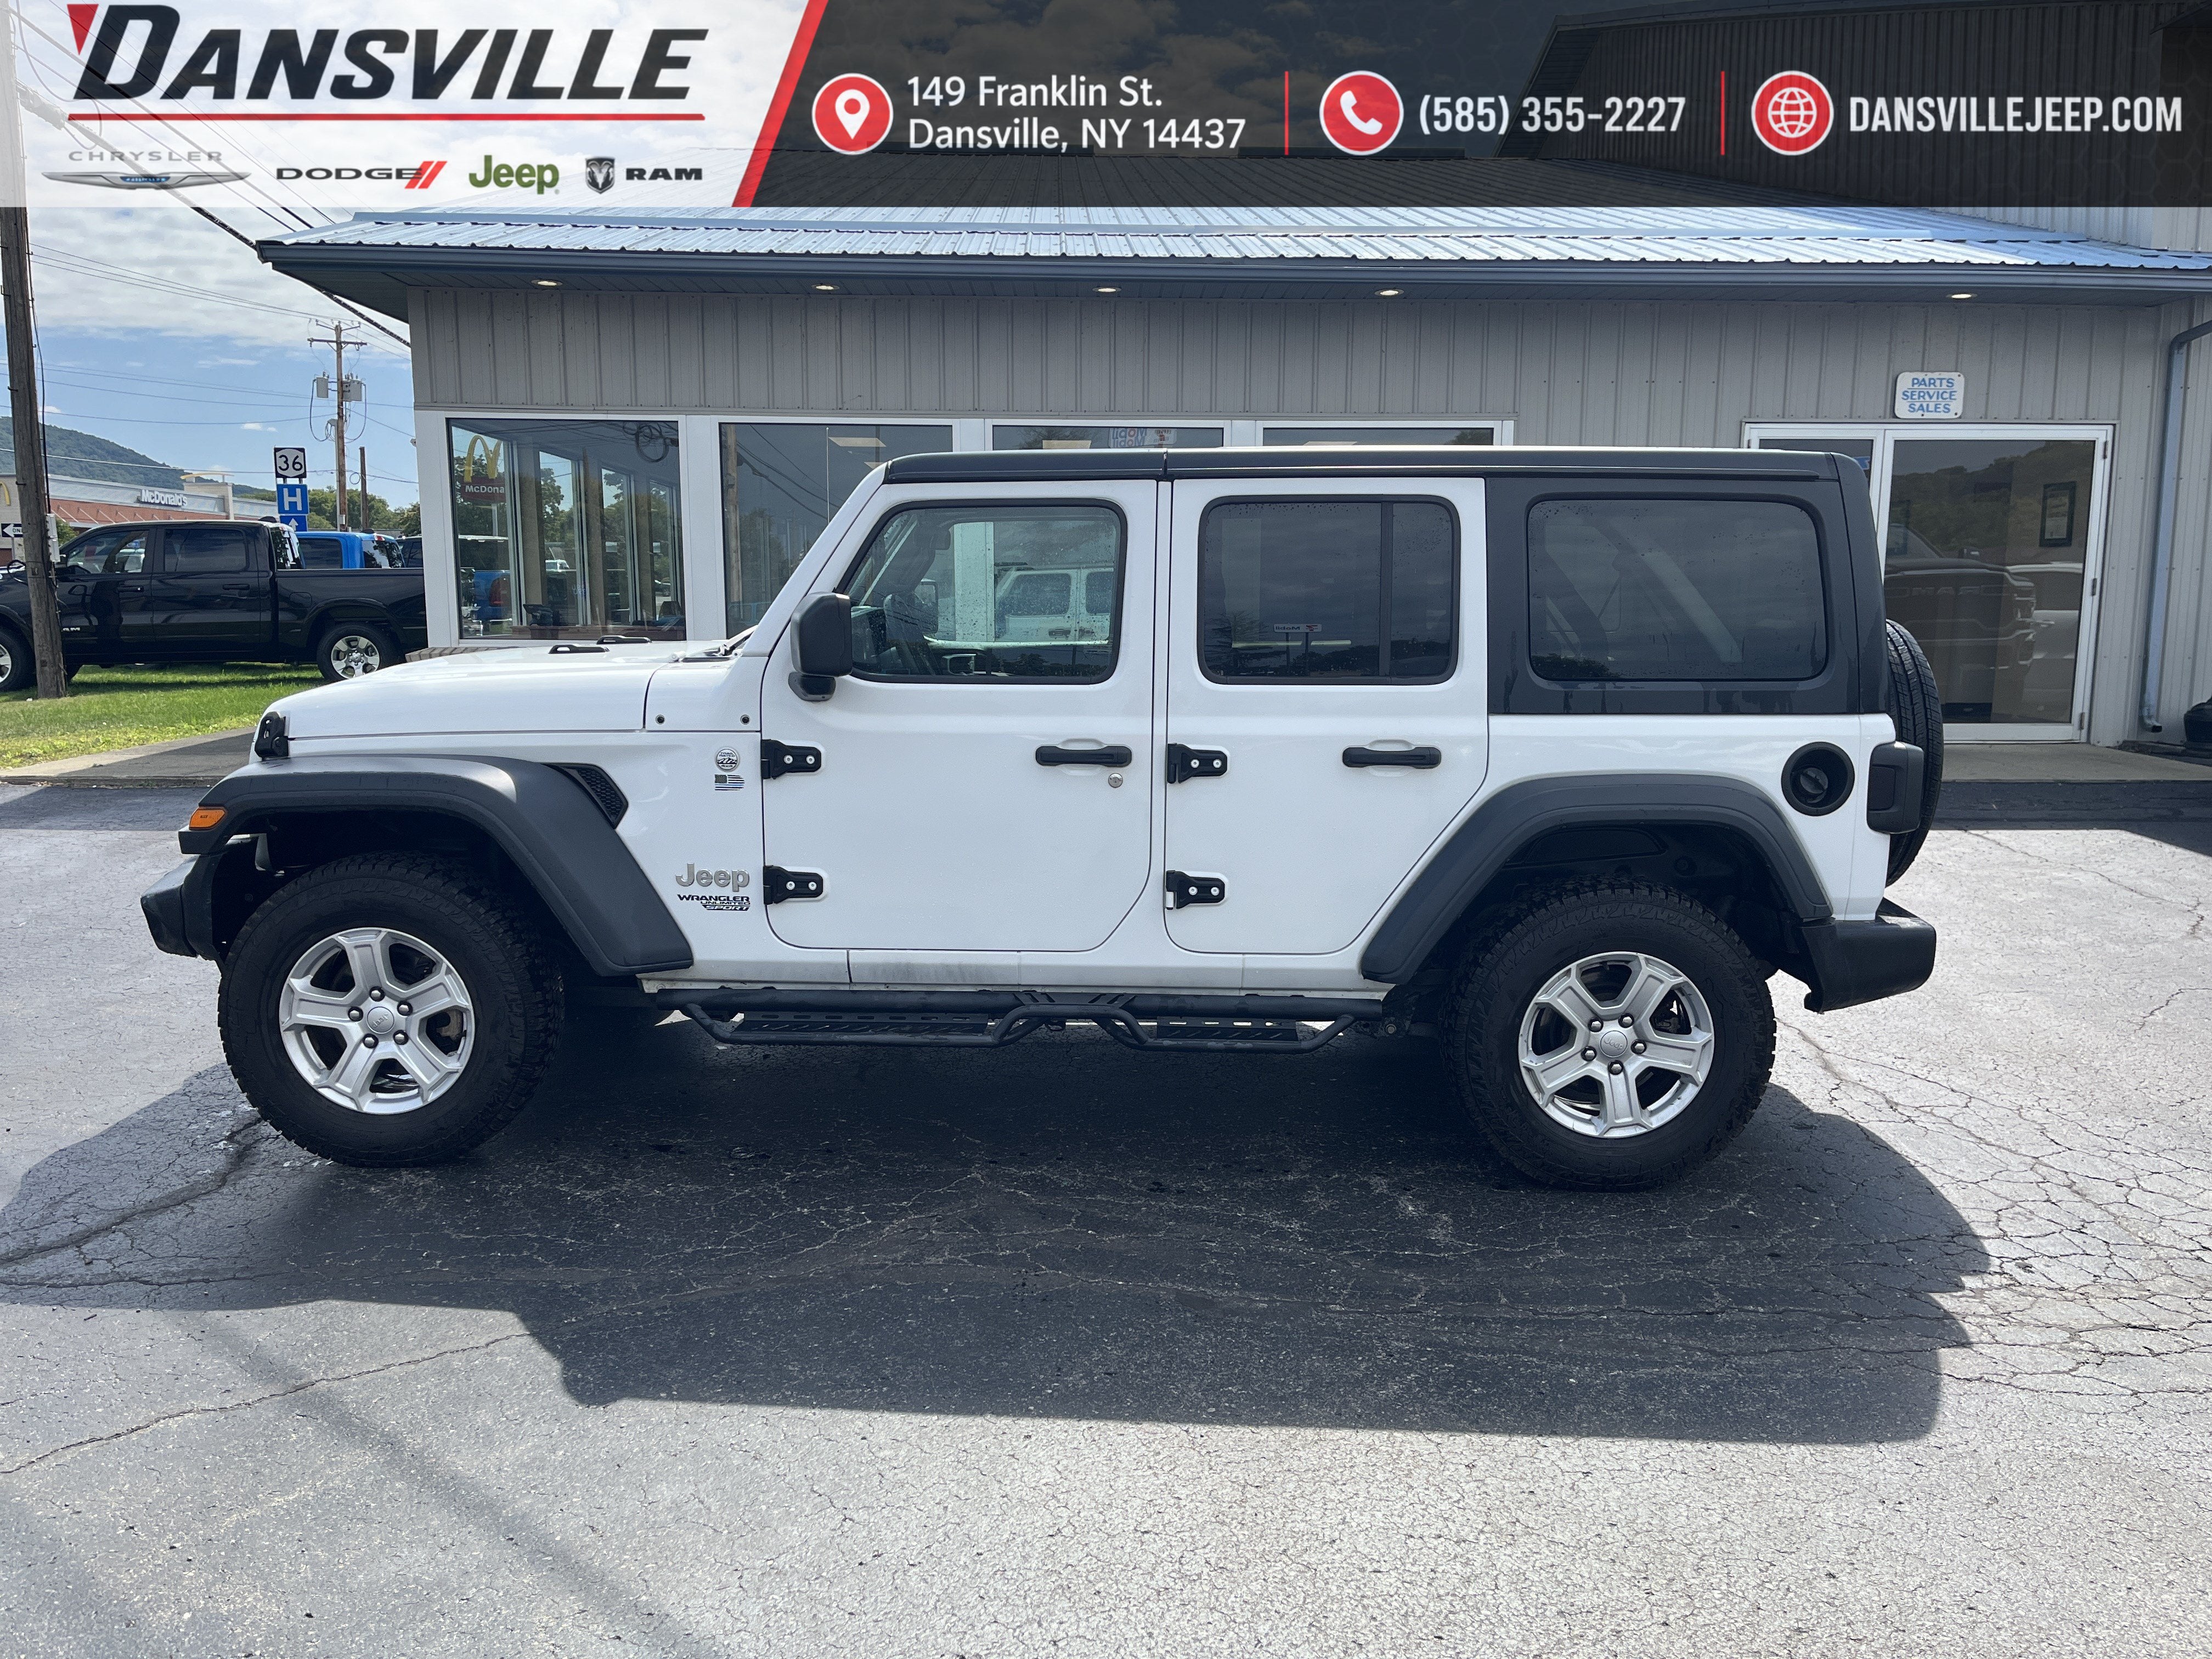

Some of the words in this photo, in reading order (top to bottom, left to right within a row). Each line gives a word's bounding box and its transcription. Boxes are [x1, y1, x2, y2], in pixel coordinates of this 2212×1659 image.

[1911, 377, 1955, 388] PARTS
[1901, 391, 1957, 400] SERVICE
[1908, 403, 1950, 413] SALES
[278, 454, 303, 471] 36
[142, 489, 188, 507] McDonald's
[283, 488, 302, 511] H
[675, 862, 750, 892] Jeep
[1604, 1037, 1623, 1050] Jeep
